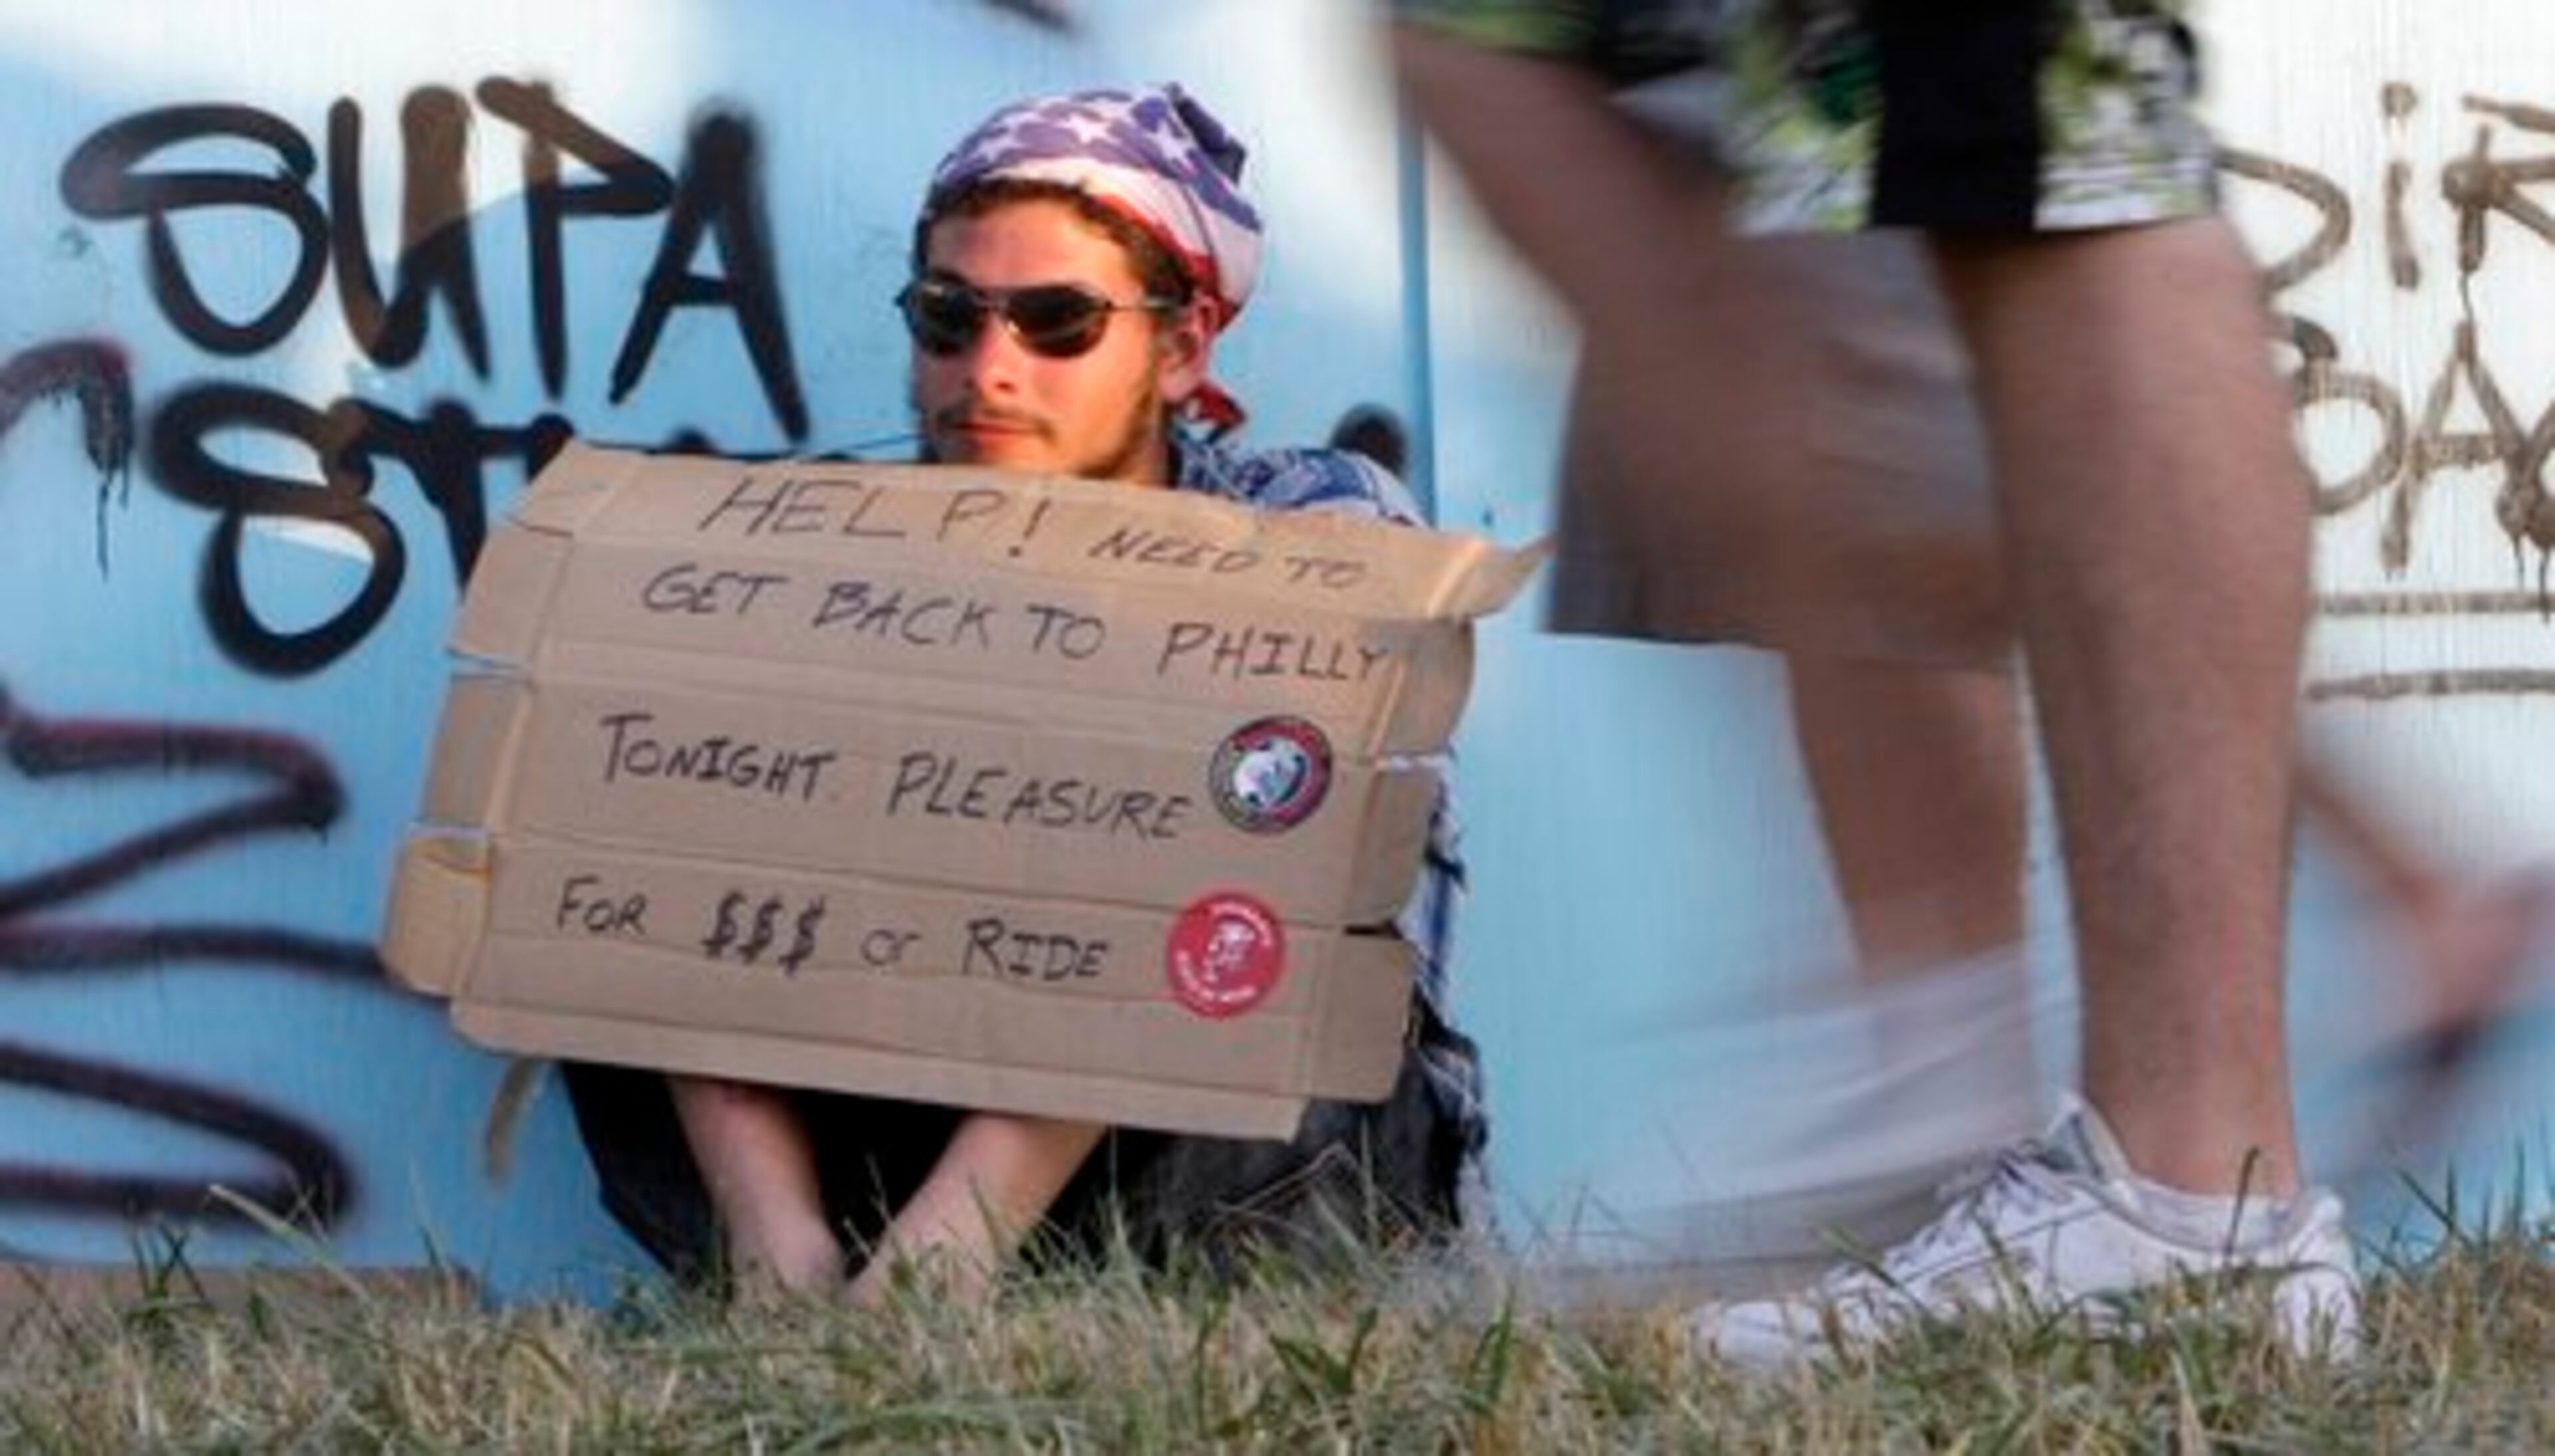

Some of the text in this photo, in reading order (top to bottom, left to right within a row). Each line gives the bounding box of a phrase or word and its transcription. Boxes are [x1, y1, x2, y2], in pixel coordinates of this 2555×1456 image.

[59, 73, 810, 446] SUPA
[697, 476, 1366, 589] HELP! NEED TO
[641, 563, 1391, 682] GET BACK TO PHILLY
[886, 750, 1197, 840] PLEASURE
[555, 876, 648, 935] FOR
[701, 889, 826, 975] $$$
[963, 917, 1113, 980] RIDE
